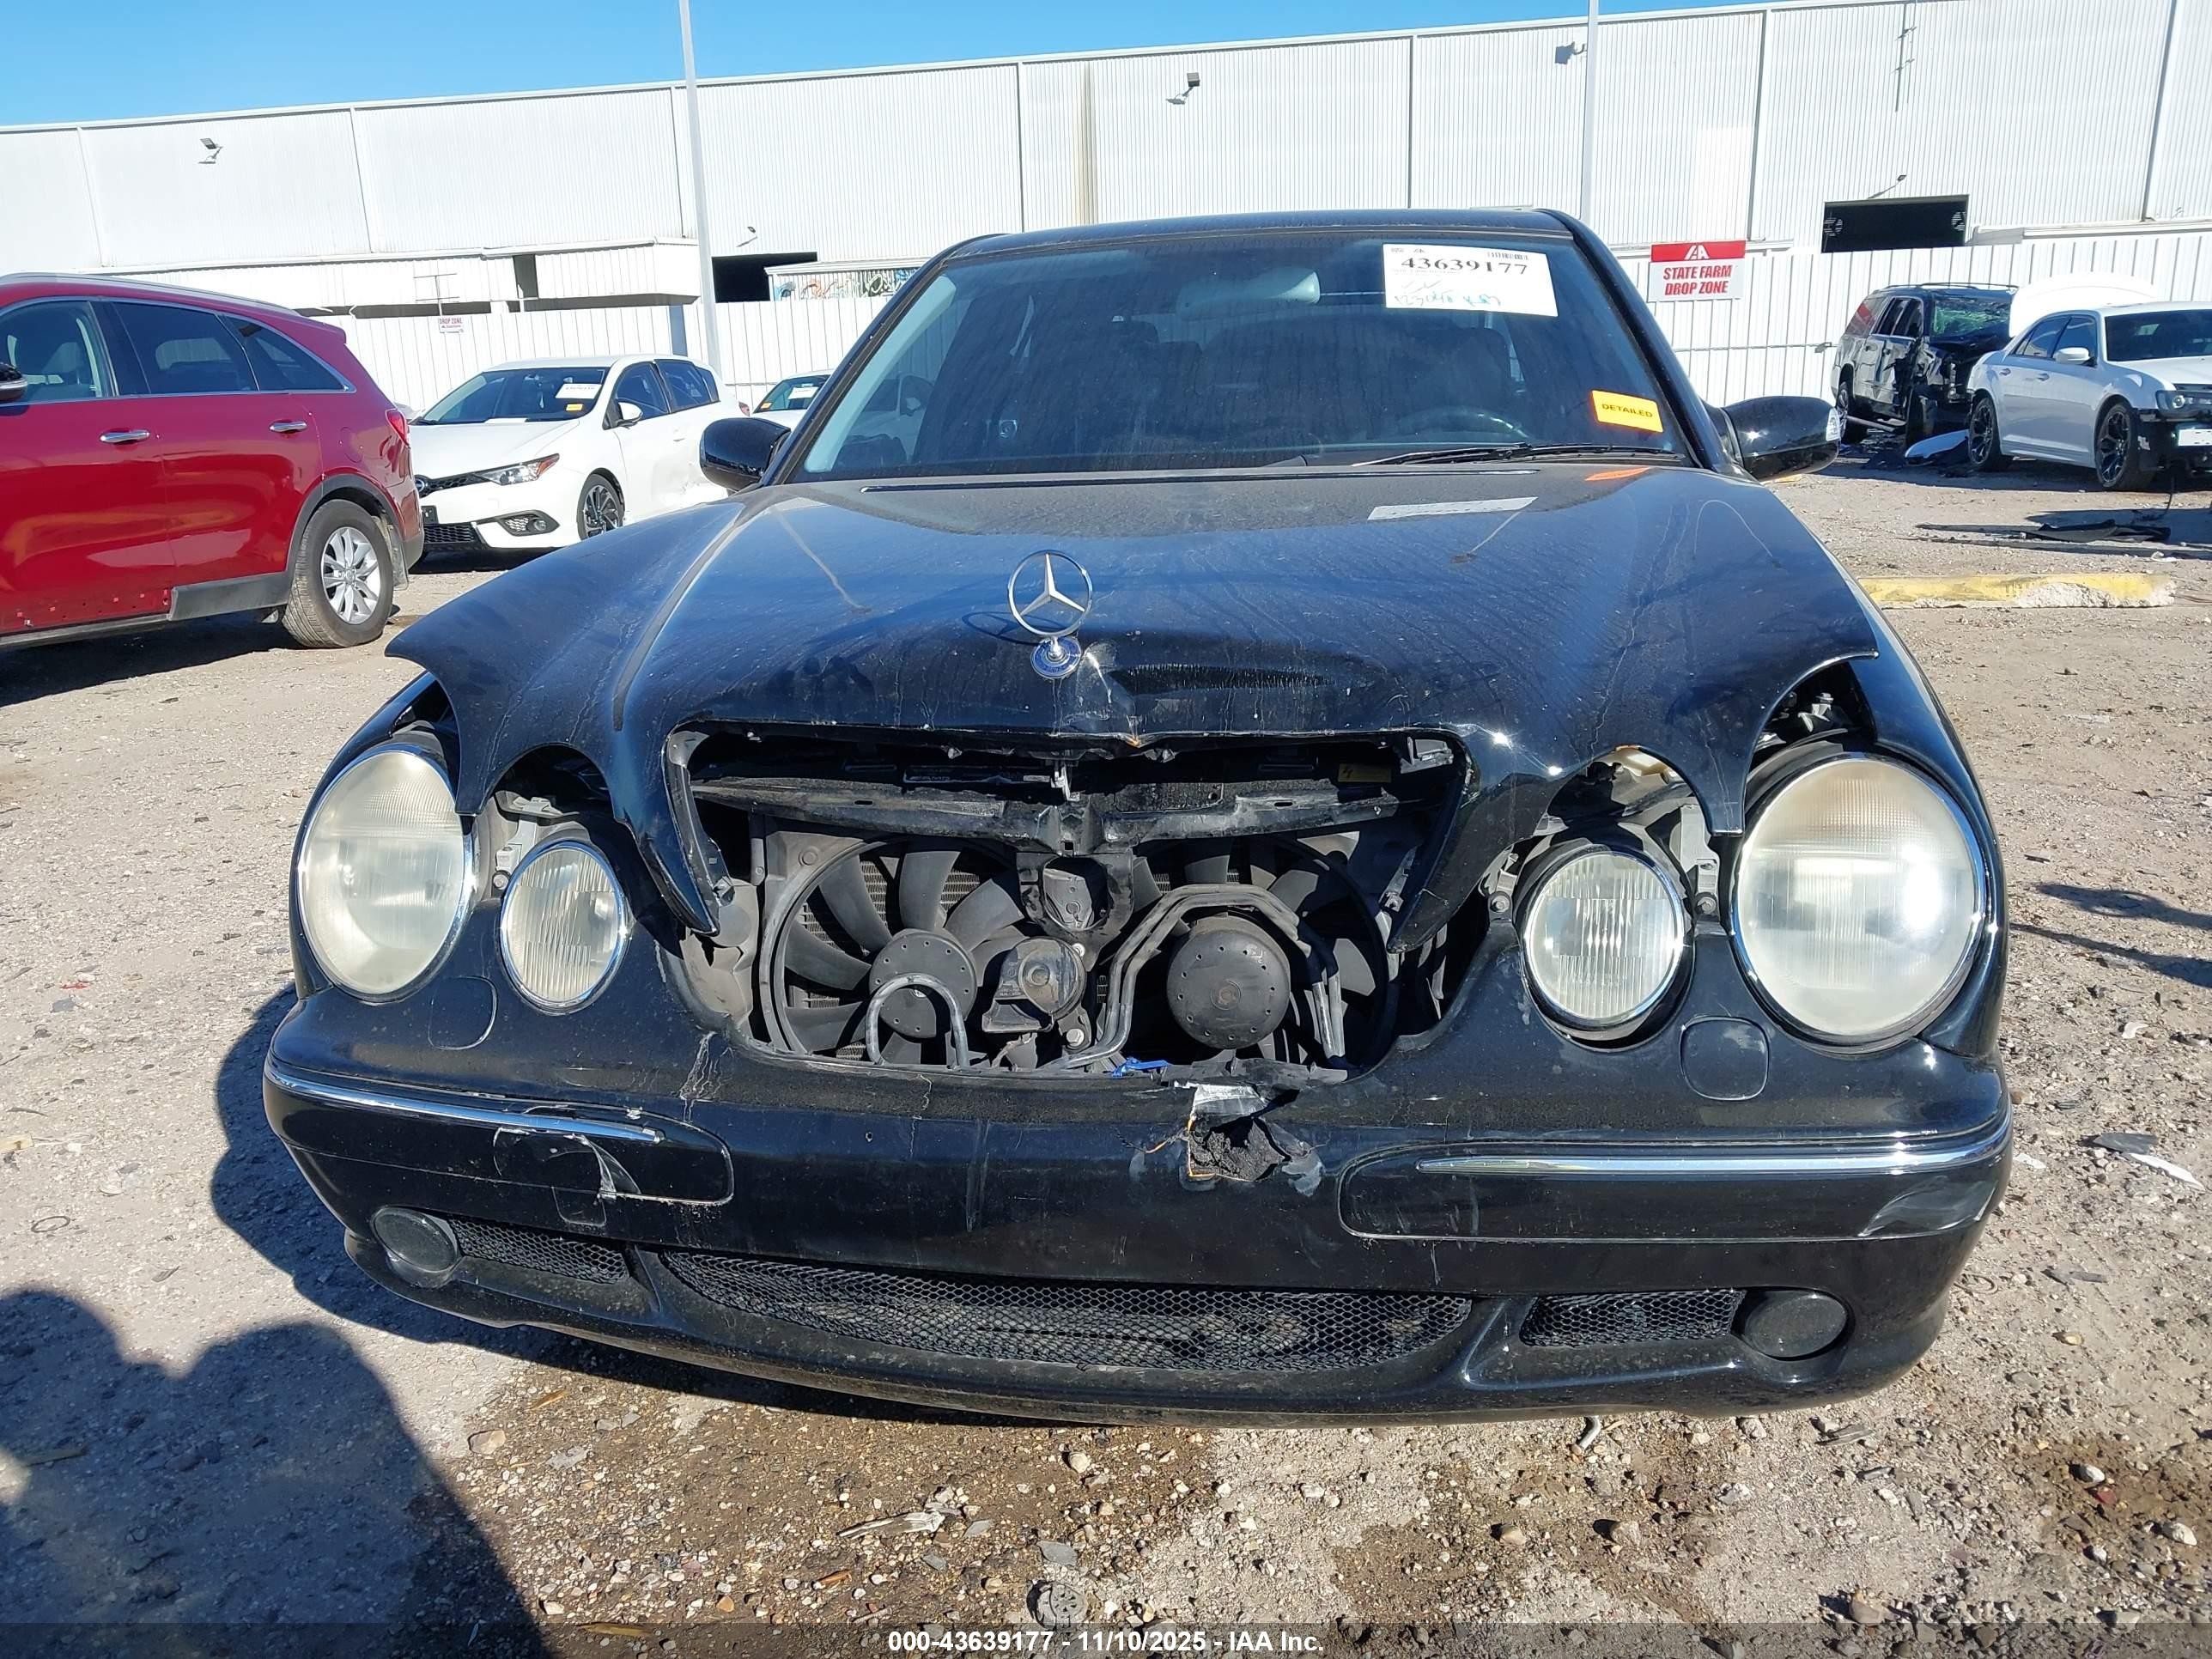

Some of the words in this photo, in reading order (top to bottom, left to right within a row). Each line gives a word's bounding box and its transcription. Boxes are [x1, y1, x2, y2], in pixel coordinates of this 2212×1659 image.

[1401, 257, 1528, 274] 43639177
[1663, 266, 1698, 280] STATE
[1700, 264, 1732, 278] FARM
[1665, 283, 1697, 295] DROP
[1698, 281, 1729, 294] ZONE
[1601, 404, 1653, 417] DETAILED
